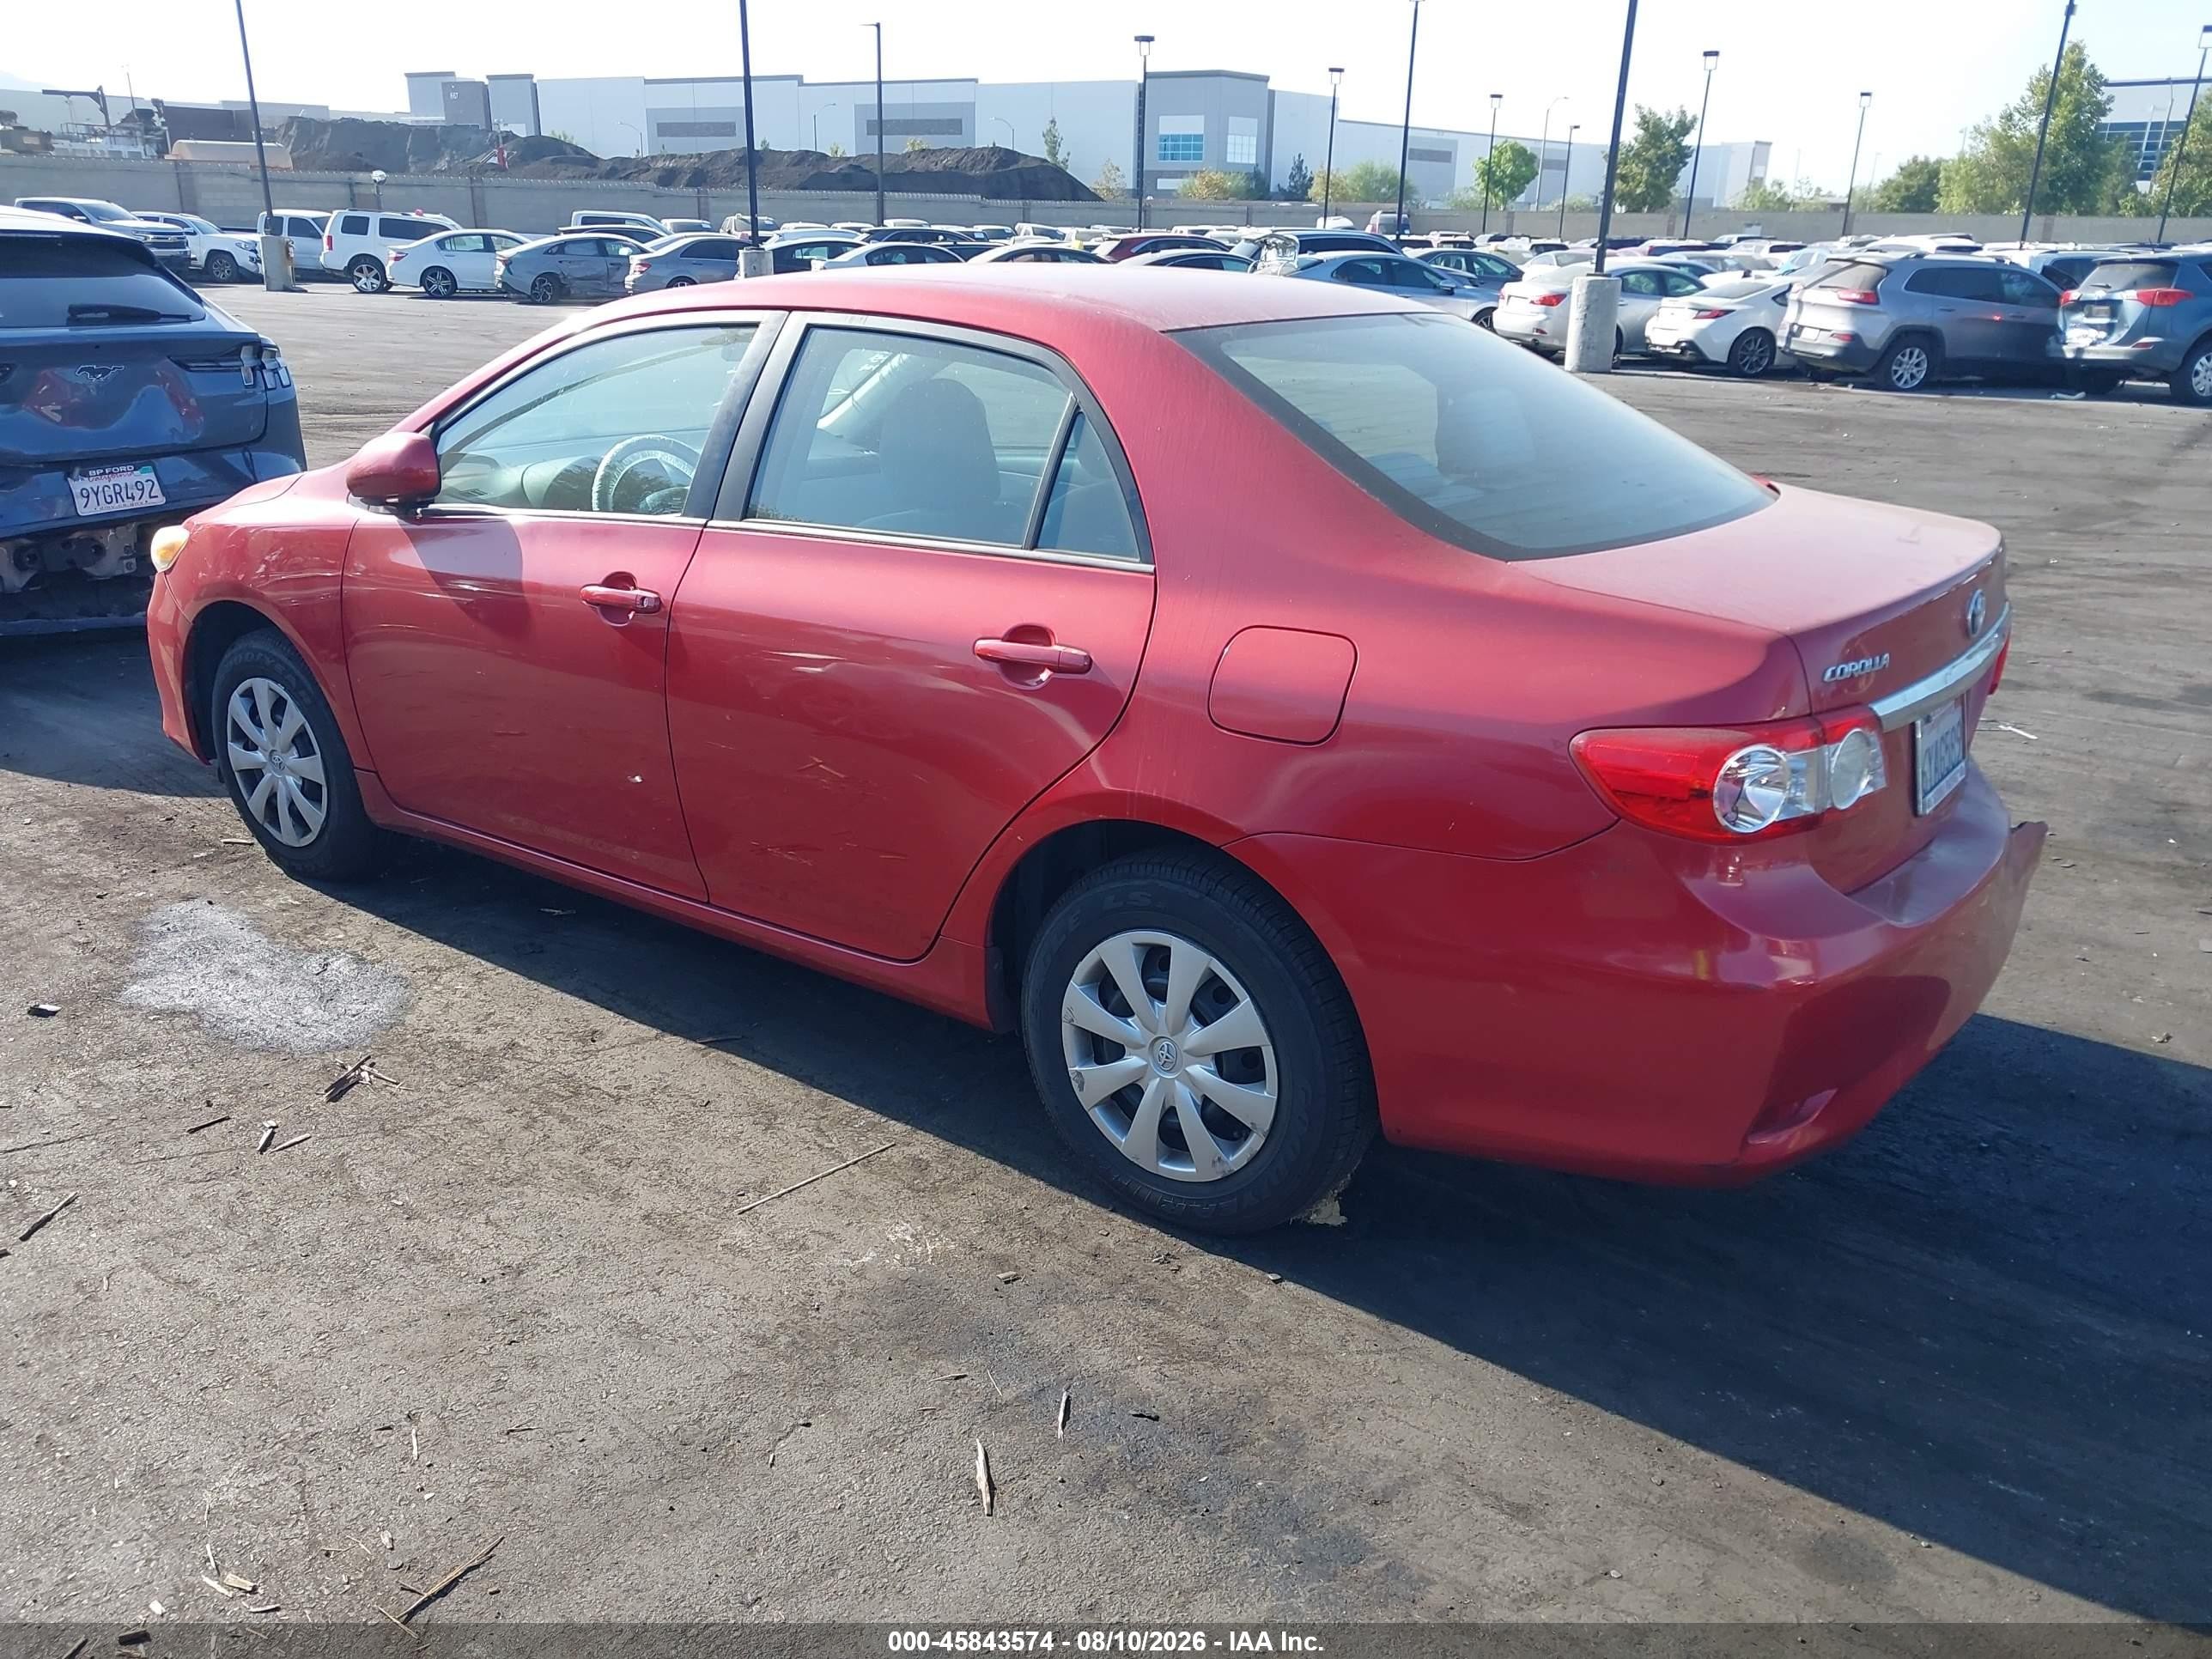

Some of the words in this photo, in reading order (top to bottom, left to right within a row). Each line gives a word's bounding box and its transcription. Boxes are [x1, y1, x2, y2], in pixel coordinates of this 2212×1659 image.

[106, 465, 134, 474] FORD
[80, 479, 158, 508] 9YGR492
[1823, 653, 1889, 682] COROLLA
